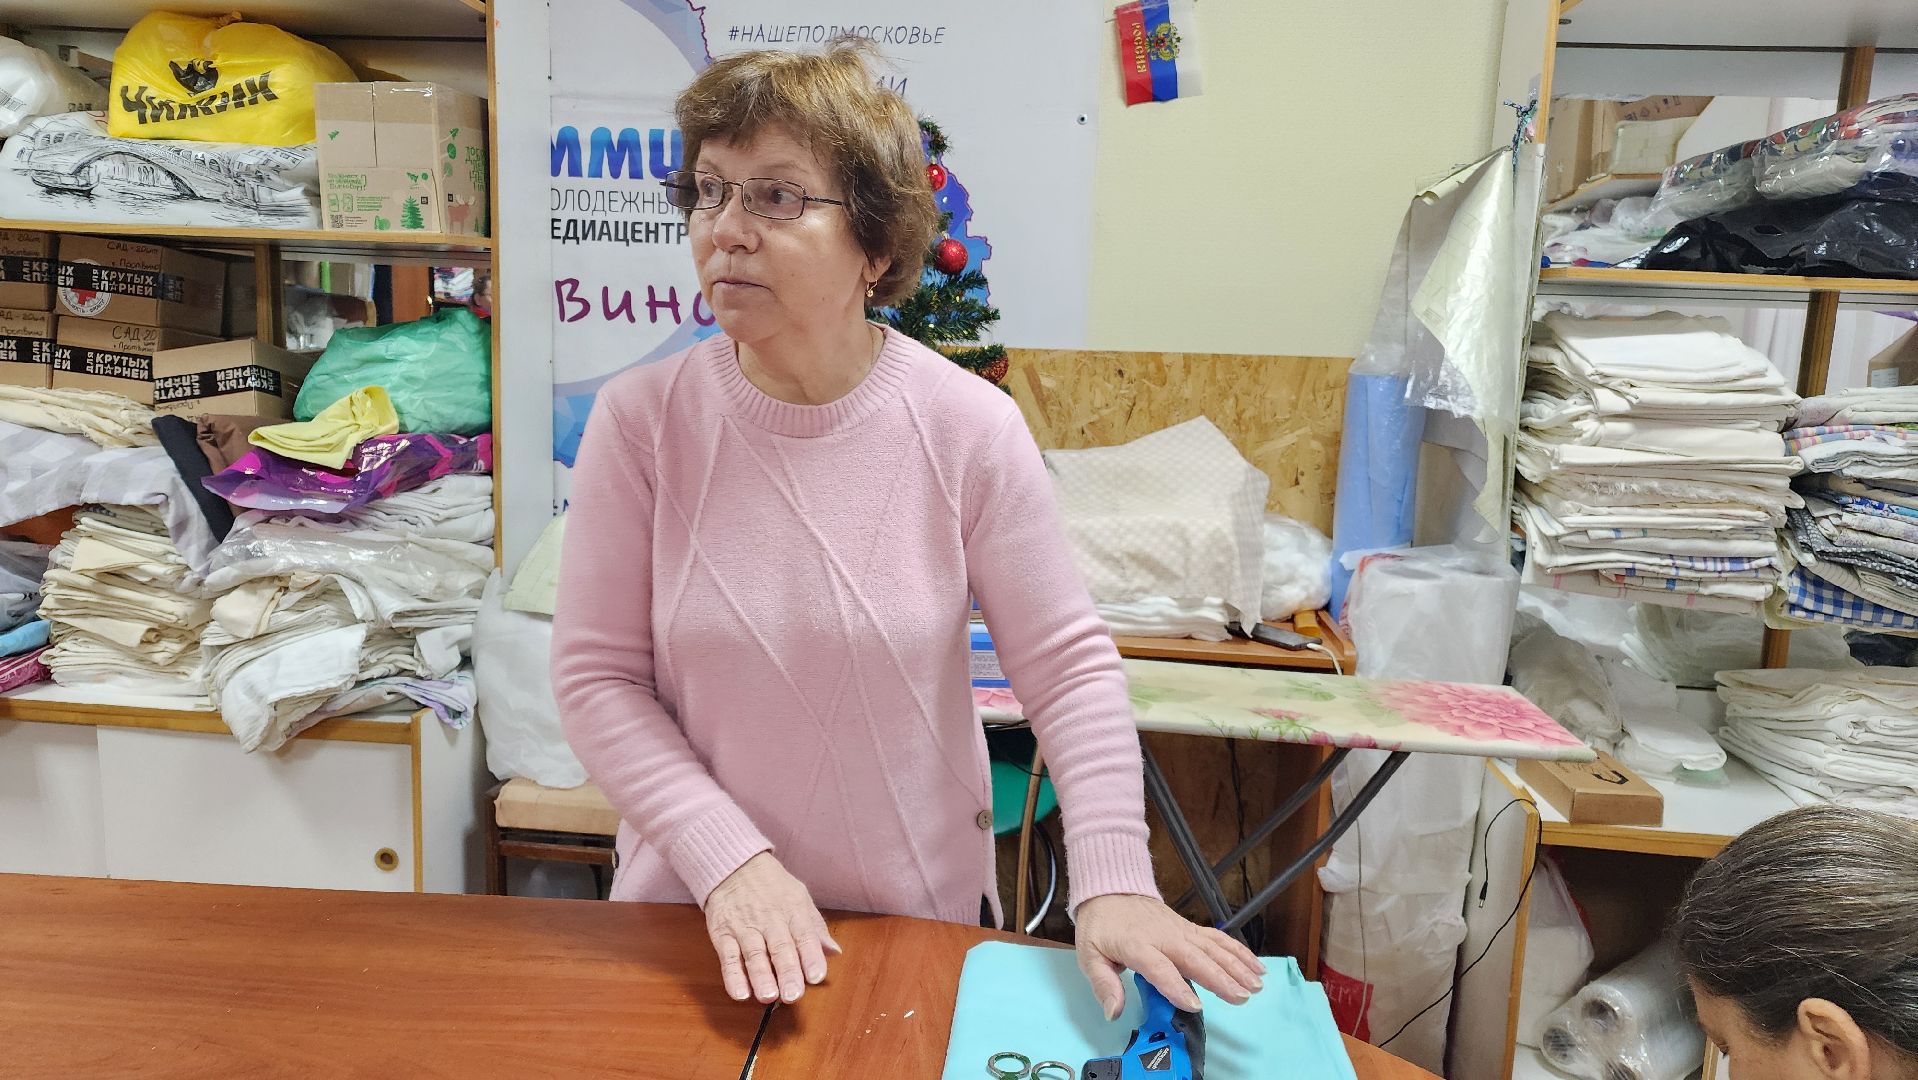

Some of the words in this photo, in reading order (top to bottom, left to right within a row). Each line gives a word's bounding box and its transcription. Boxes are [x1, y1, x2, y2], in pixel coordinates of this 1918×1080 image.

[728, 24, 946, 45] #НАШЕПОДМОСКОВЬЕ
[1131, 22, 1147, 73] РОССИЯ
[101, 269, 153, 285] КРУТЫХ
[95, 353, 149, 369] КРУТЫХ
